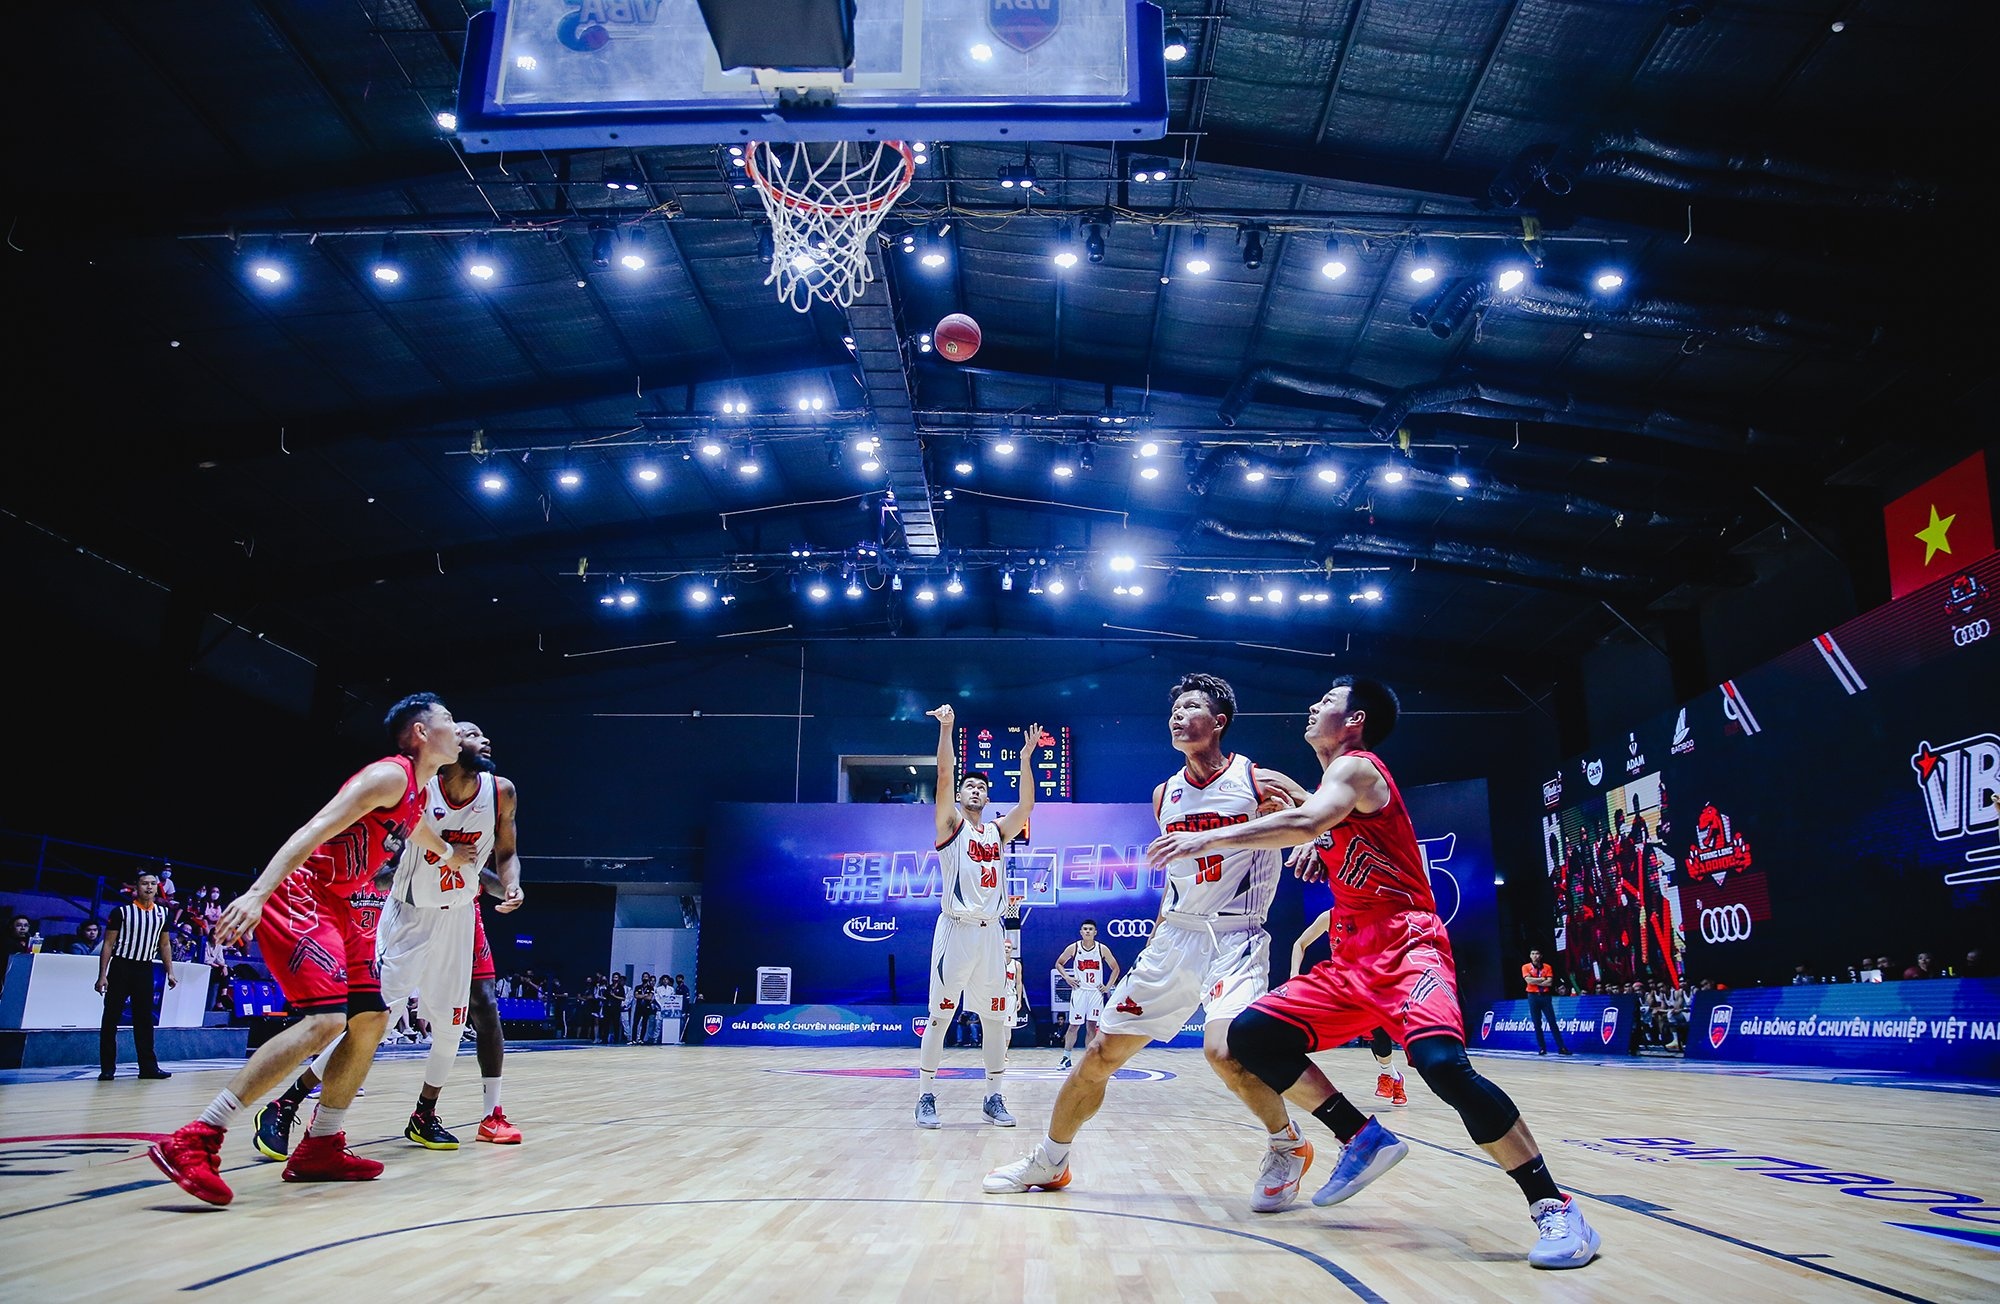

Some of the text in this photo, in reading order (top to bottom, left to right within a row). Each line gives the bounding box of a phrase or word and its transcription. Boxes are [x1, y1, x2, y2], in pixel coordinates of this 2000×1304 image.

[980, 750, 990, 759] 41
[1044, 750, 1053, 760] 39
[1626, 754, 1645, 772] ADAM
[1010, 776, 1017, 788] 2
[842, 852, 882, 877] BE
[1195, 854, 1224, 885] 10
[980, 866, 997, 888] 20
[823, 875, 882, 901] THE
[361, 909, 375, 929] 21
[1085, 972, 1096, 983] 12
[991, 997, 1006, 1011] 20
[706, 1017, 721, 1025] VBA
[1604, 1011, 1616, 1023] VBA
[1713, 1010, 1730, 1024] VBA
[732, 1021, 750, 1030] GIẢI
[751, 1021, 776, 1030] BÓNG
[792, 1021, 826, 1031] CHUYÊN
[828, 1021, 860, 1033] NGHIỆP
[862, 1022, 881, 1033] VIỆT
[1579, 1021, 1595, 1032] NAM
[1740, 1016, 1763, 1035] GIẢI
[1763, 1017, 1796, 1036] BÓNG
[1797, 1014, 1818, 1036] RỔ
[1817, 1016, 1869, 1037] CHUYÊN
[1872, 1016, 1928, 1043] NGHIỆP
[1930, 1016, 1968, 1044] VIỆT
